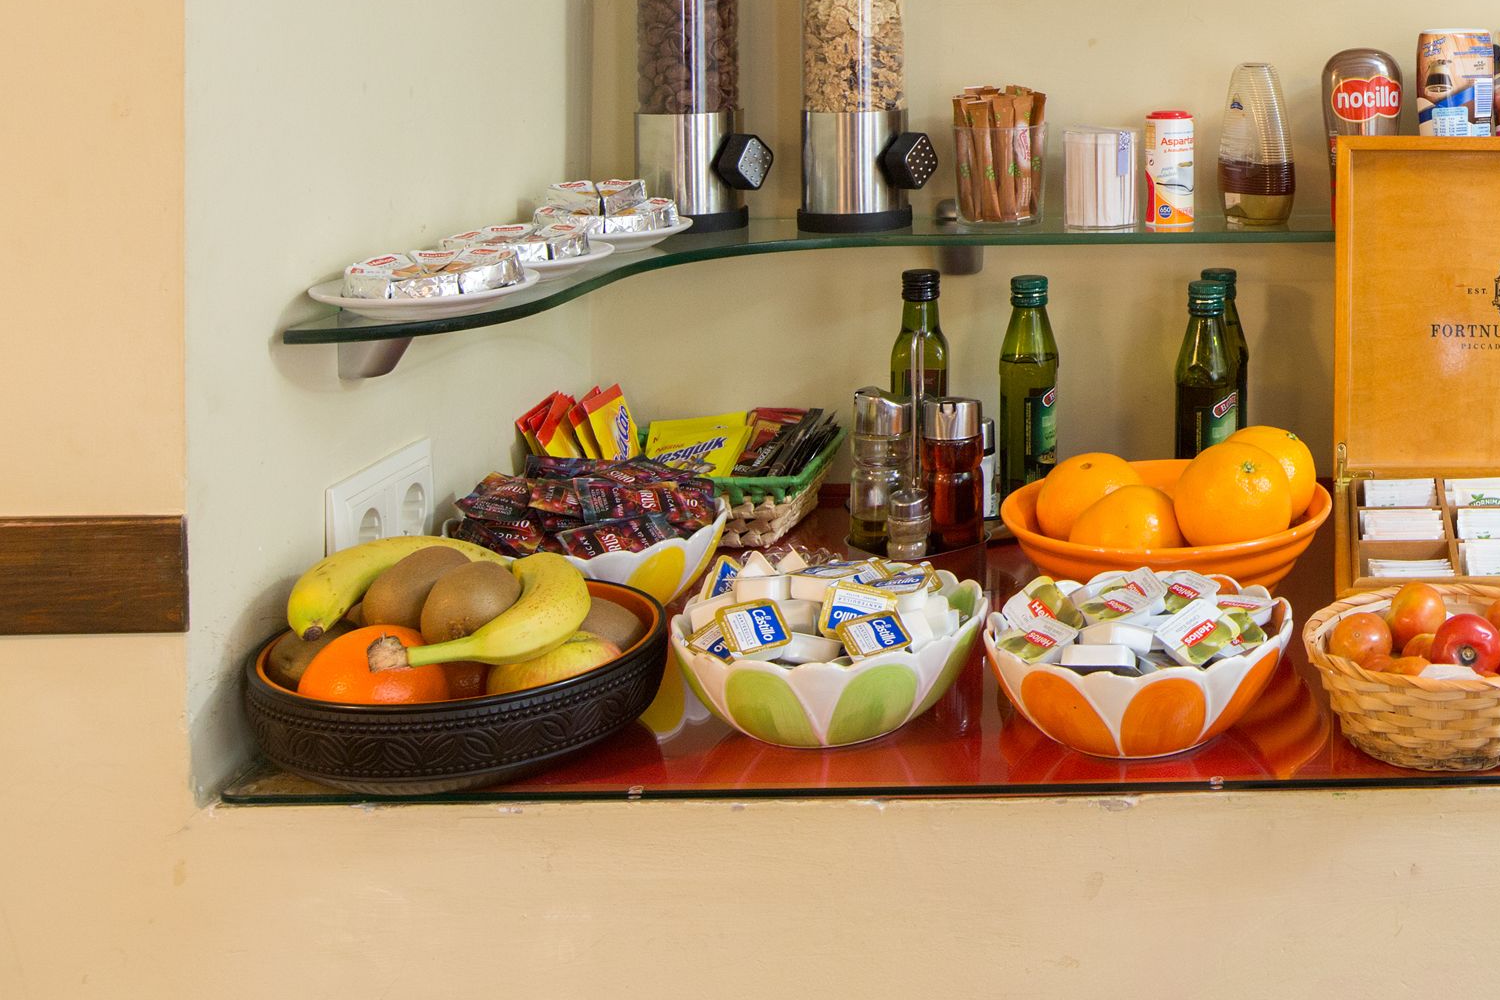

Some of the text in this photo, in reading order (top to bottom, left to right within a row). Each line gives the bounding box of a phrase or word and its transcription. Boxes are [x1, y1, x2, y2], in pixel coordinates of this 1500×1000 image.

[1337, 86, 1399, 109] nocilla
[1467, 287, 1488, 295] EST.
[1172, 584, 1198, 599] Helios
[752, 609, 776, 642] Castillo
[872, 619, 897, 646] Castillo
[1184, 622, 1215, 645] Helios
[1028, 632, 1054, 648] Helios
